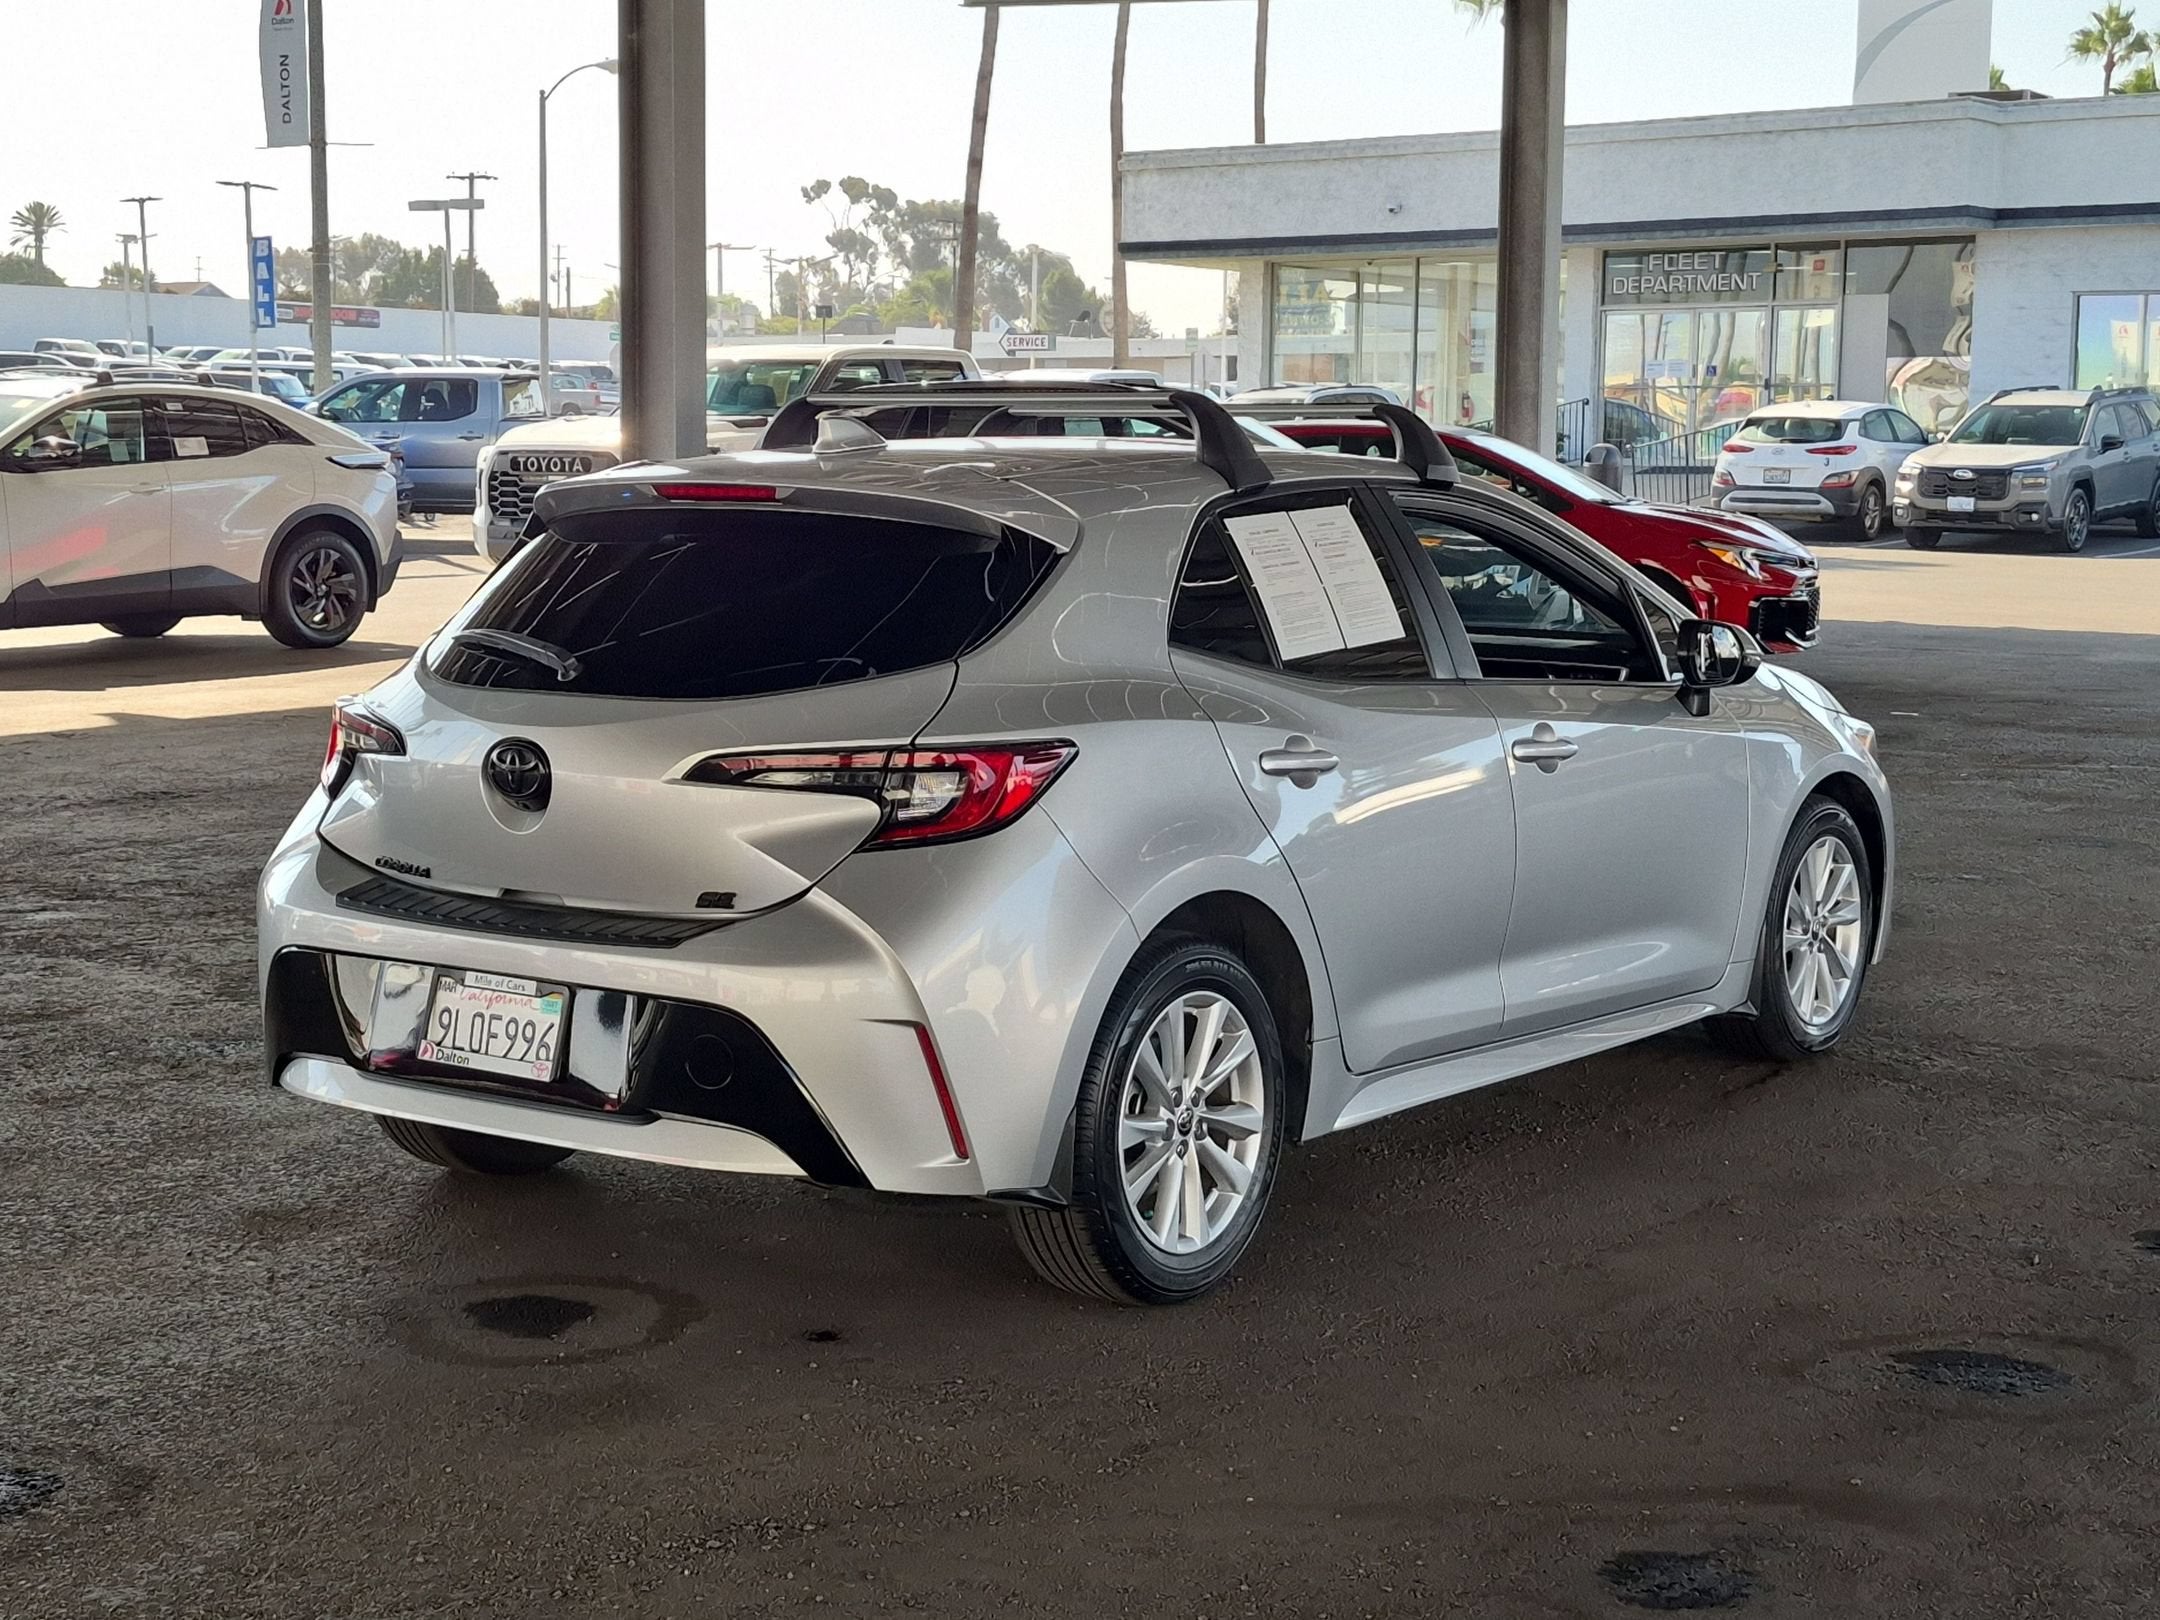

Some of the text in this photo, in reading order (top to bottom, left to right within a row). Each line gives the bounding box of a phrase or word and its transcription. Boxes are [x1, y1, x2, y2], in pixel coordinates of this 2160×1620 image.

[280, 54, 292, 124] DALTON
[255, 239, 272, 326] BALL
[1612, 272, 1761, 295] DEPARTMENT
[1006, 337, 1046, 347] SERVICE
[517, 456, 584, 472] TOYOTA
[438, 979, 457, 994] MAR
[474, 974, 525, 992] Mile of Cars
[460, 985, 540, 1009] California
[435, 1048, 470, 1066] Dalton
